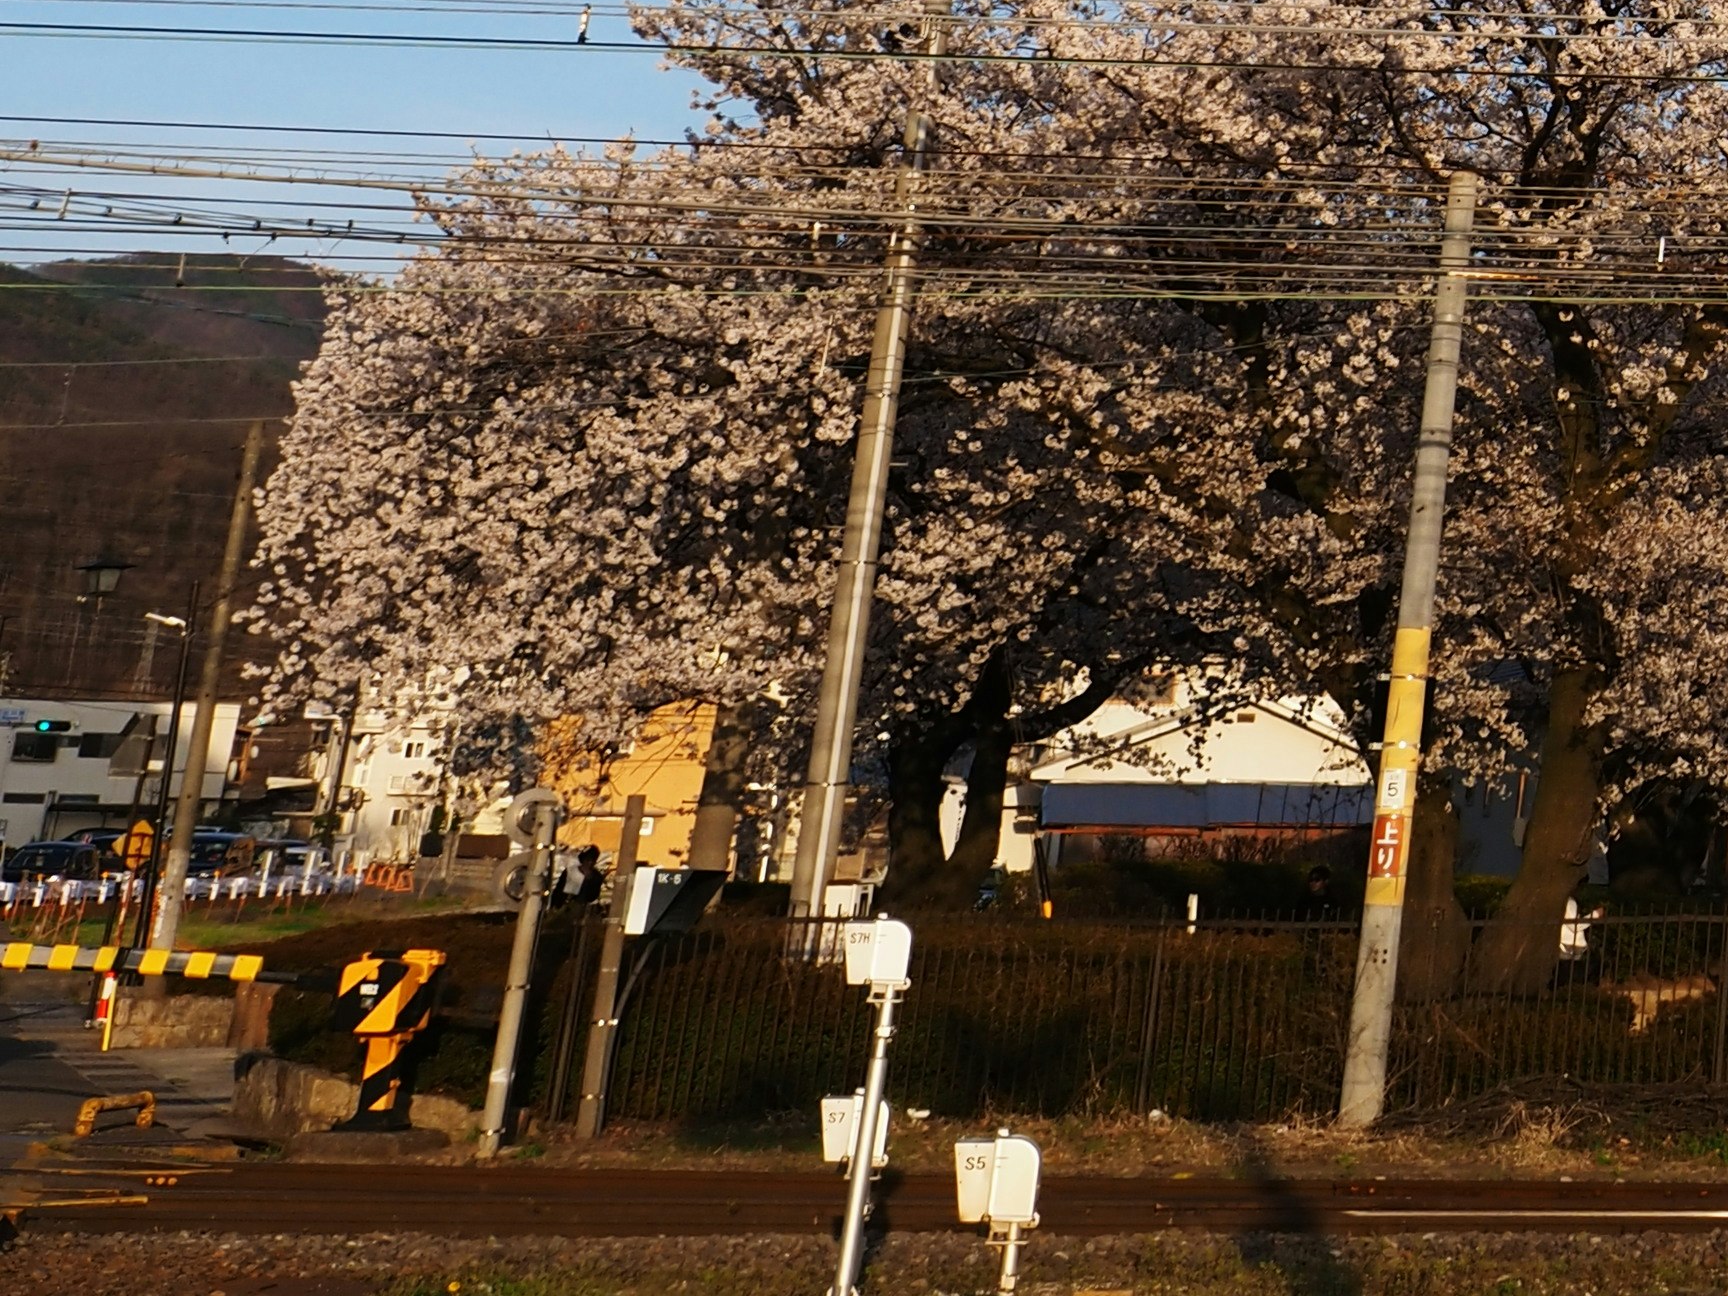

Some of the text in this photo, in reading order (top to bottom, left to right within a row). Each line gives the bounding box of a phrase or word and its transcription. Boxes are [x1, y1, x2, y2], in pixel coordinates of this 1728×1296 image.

[1387, 782, 1399, 797] 5
[1376, 822, 1399, 870] 上り
[850, 932, 871, 944] S7H
[828, 1112, 846, 1124] S7
[965, 1156, 987, 1171] S5
